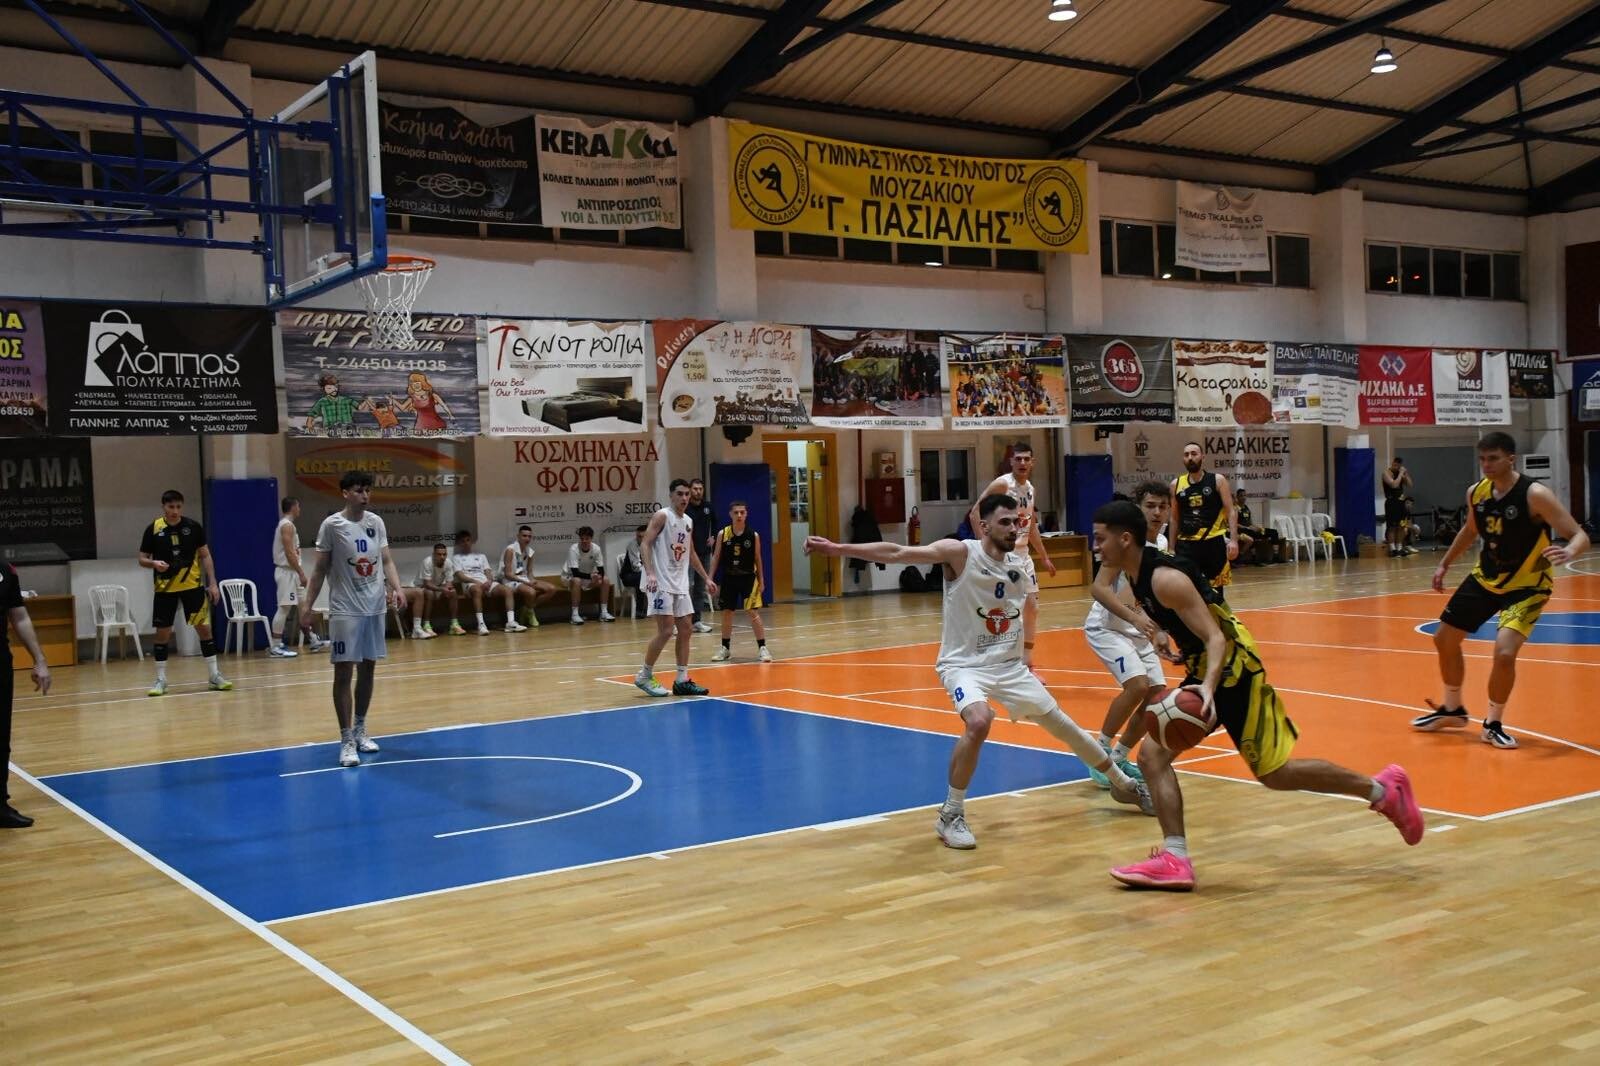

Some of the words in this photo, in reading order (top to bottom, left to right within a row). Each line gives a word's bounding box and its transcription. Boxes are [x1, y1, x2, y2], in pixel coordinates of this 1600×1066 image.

[804, 140, 935, 177] ΓΥΜΝΑΣΤΙΚΟΣ
[939, 157, 1028, 185] ΣΥΛΛΟΓΟΣ
[870, 175, 975, 205] ΜΟΥΖΑΚΙΟΥ
[748, 327, 793, 349] ΑΓΟΡΑ
[656, 322, 697, 369] Delivery
[337, 357, 391, 370] 24450
[396, 359, 447, 372] 41035
[1105, 358, 1137, 375] 365
[116, 375, 241, 389] ΠΟΛΥΚΑΤΑΣΤΗΜΑ
[511, 376, 526, 386] Bed
[514, 388, 546, 397] Passion
[1358, 380, 1406, 397] ΜΙΧΑΗΛ
[79, 392, 116, 400] ΕΝΔΥΜΑΤΑ
[70, 417, 120, 428] ΓΙΑΝΝΗΣ
[125, 418, 170, 429] ΛΑΠΠΑΣ
[203, 424, 225, 432] 24450
[226, 423, 248, 432] 42707
[513, 440, 660, 464] ΚΟΣΜΗΜΑΤΑ
[1204, 436, 1291, 455] ΚΑΡΑΚΙΚΕΣ
[1214, 459, 1253, 469] ΕΜΠΟΡΙΚΟ
[1255, 458, 1284, 468] ΚΕΝΤΡΟ
[374, 473, 469, 488] MARKET
[536, 465, 641, 493] ΦΩΤΙΟΥ
[576, 501, 614, 515] BOSS
[625, 502, 663, 515] SEIKO
[677, 532, 686, 544] 12
[355, 539, 368, 553] 10
[289, 593, 295, 601] 5
[994, 581, 1005, 599] 8
[653, 598, 664, 610] 12
[333, 641, 346, 655] 10
[1115, 656, 1125, 674] 7
[954, 686, 965, 702] 8
